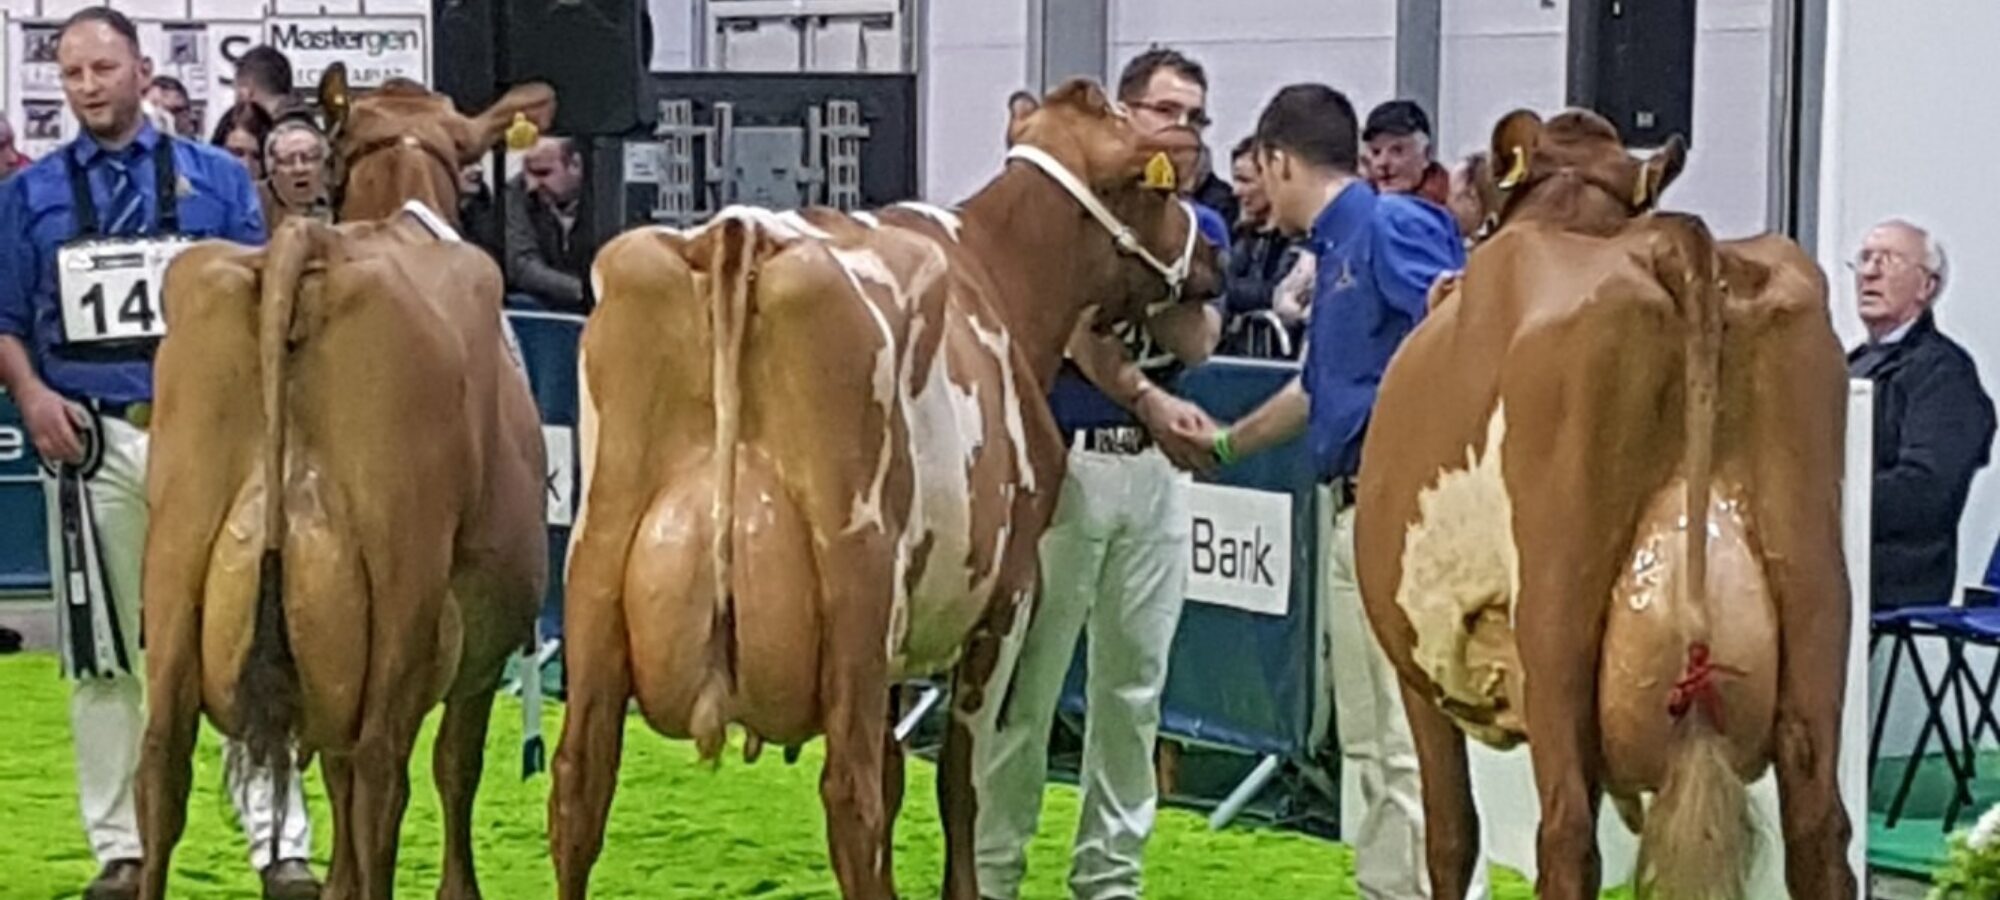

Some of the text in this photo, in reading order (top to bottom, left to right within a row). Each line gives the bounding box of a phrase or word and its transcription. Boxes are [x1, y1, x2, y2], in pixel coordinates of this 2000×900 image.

[271, 24, 418, 56] Mastergen
[80, 278, 166, 335] 14
[1192, 517, 1274, 587] Bank
